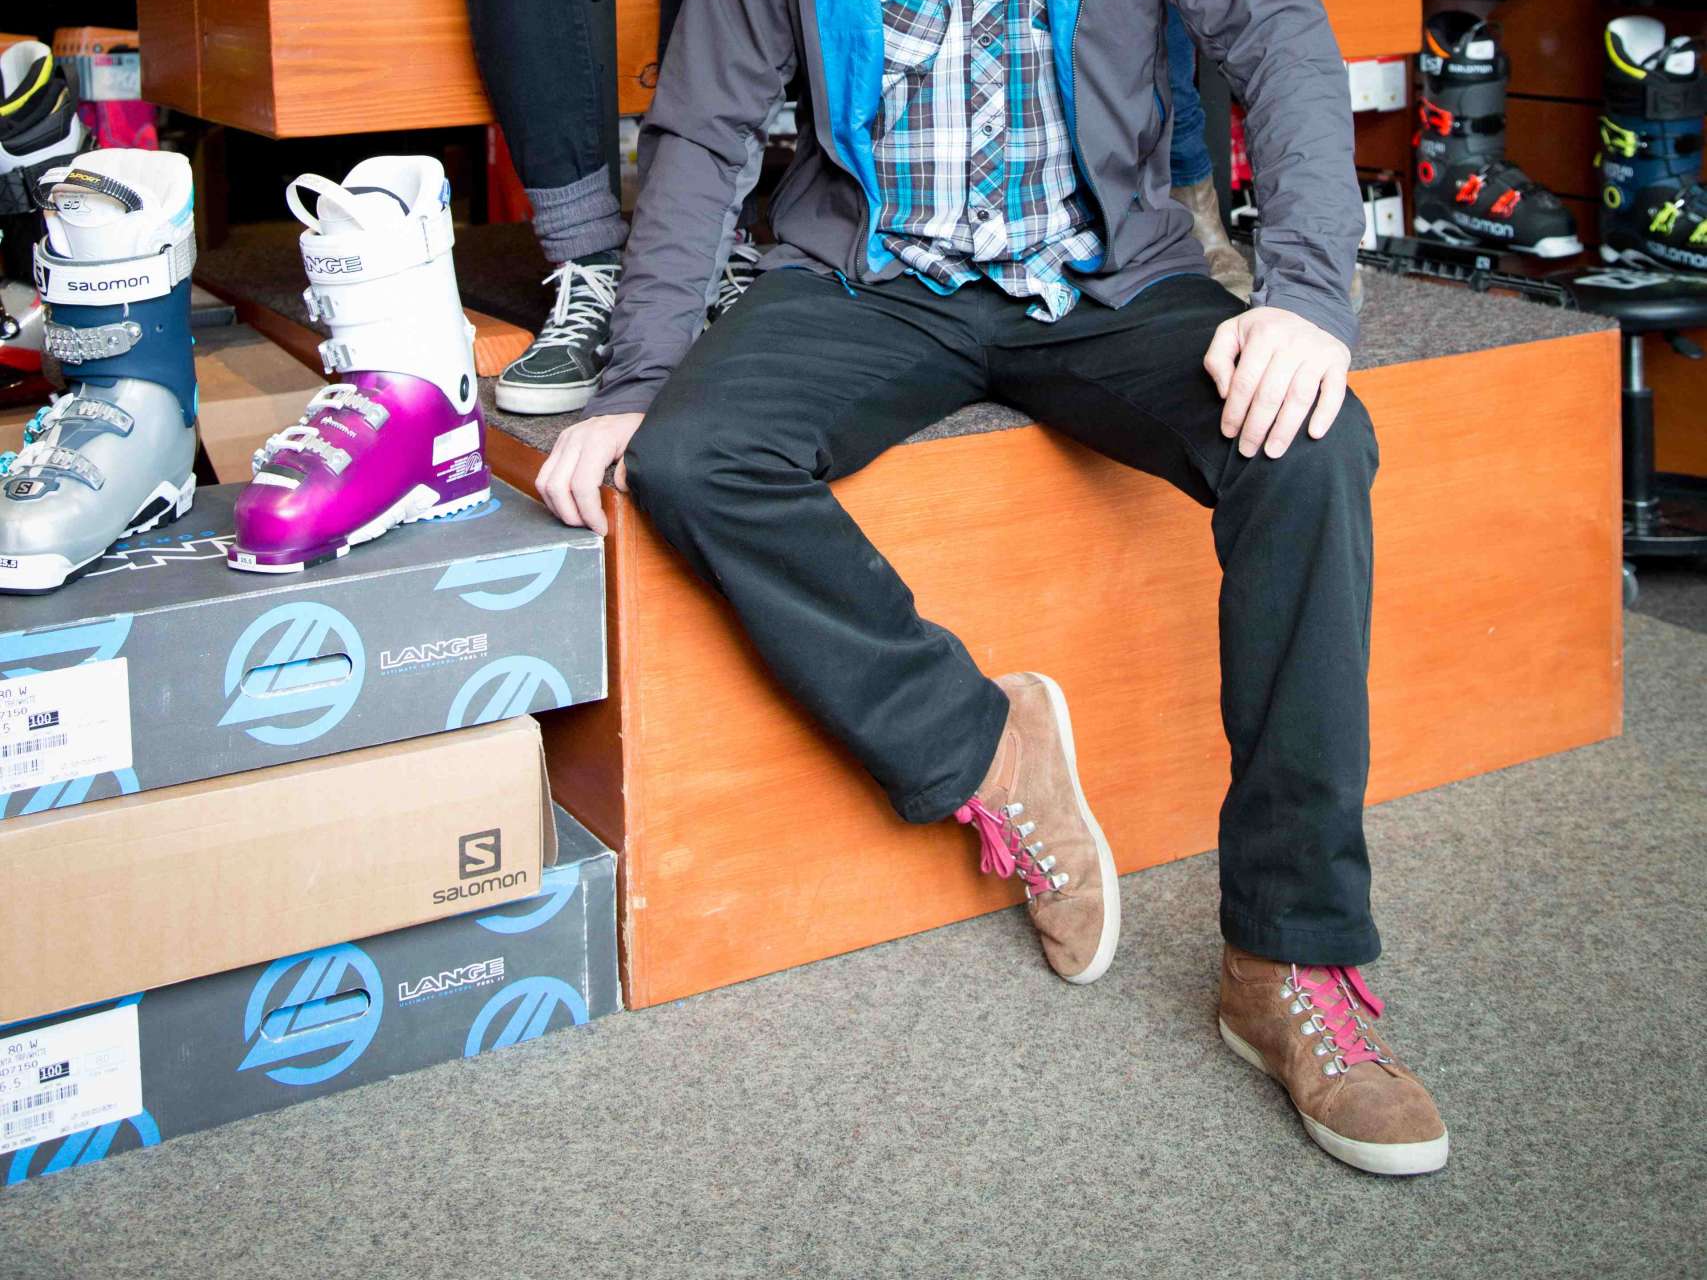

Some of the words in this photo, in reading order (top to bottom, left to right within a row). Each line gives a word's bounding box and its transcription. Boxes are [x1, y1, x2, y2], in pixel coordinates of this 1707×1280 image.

[69, 172, 101, 184] SPORT
[304, 256, 363, 274] NGE
[67, 275, 150, 292] salomon
[380, 634, 487, 670] LANGE
[462, 832, 498, 876] S
[433, 870, 527, 904] salomon
[399, 957, 504, 1001] LANGE
[0, 1060, 38, 1077] D7150
